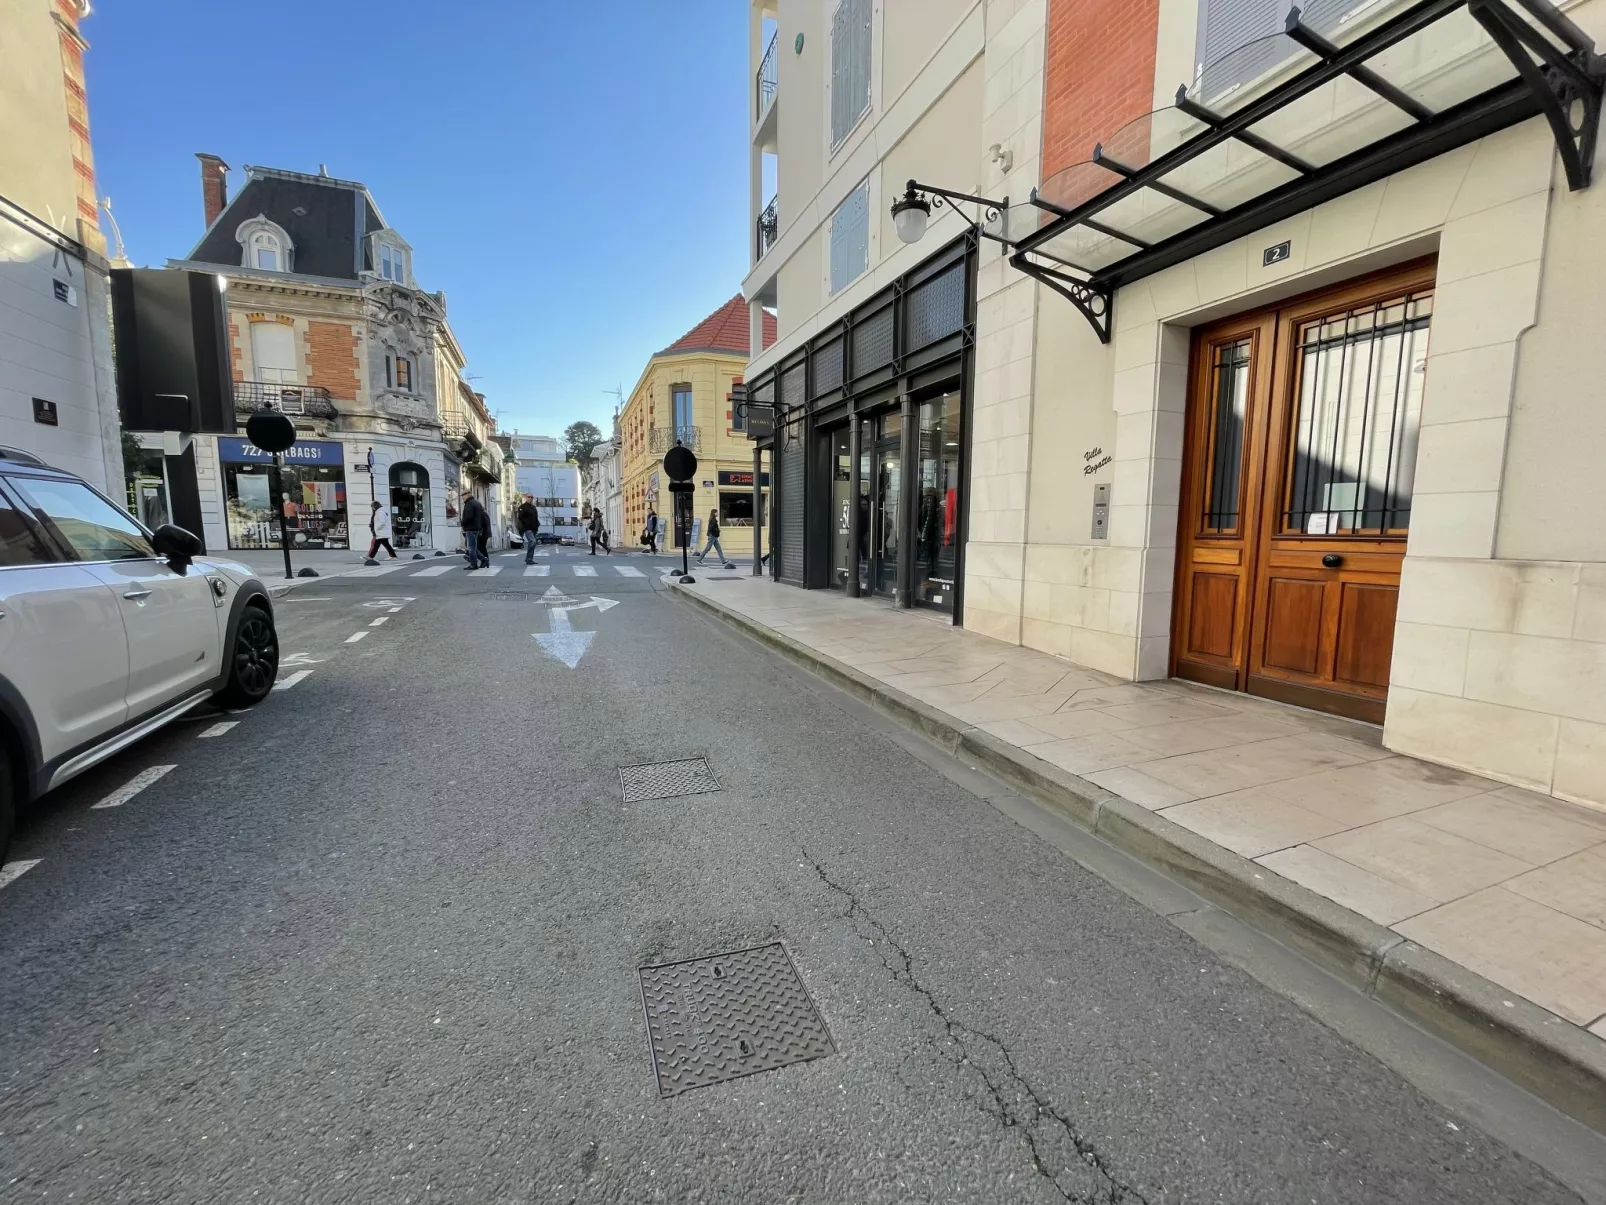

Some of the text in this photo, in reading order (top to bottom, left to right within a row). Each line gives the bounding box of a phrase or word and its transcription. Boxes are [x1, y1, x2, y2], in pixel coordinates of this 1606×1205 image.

[1272, 248, 1280, 260] 2
[242, 444, 262, 456] 727
[1083, 446, 1103, 462] Villa
[1083, 455, 1113, 477] Regatta
